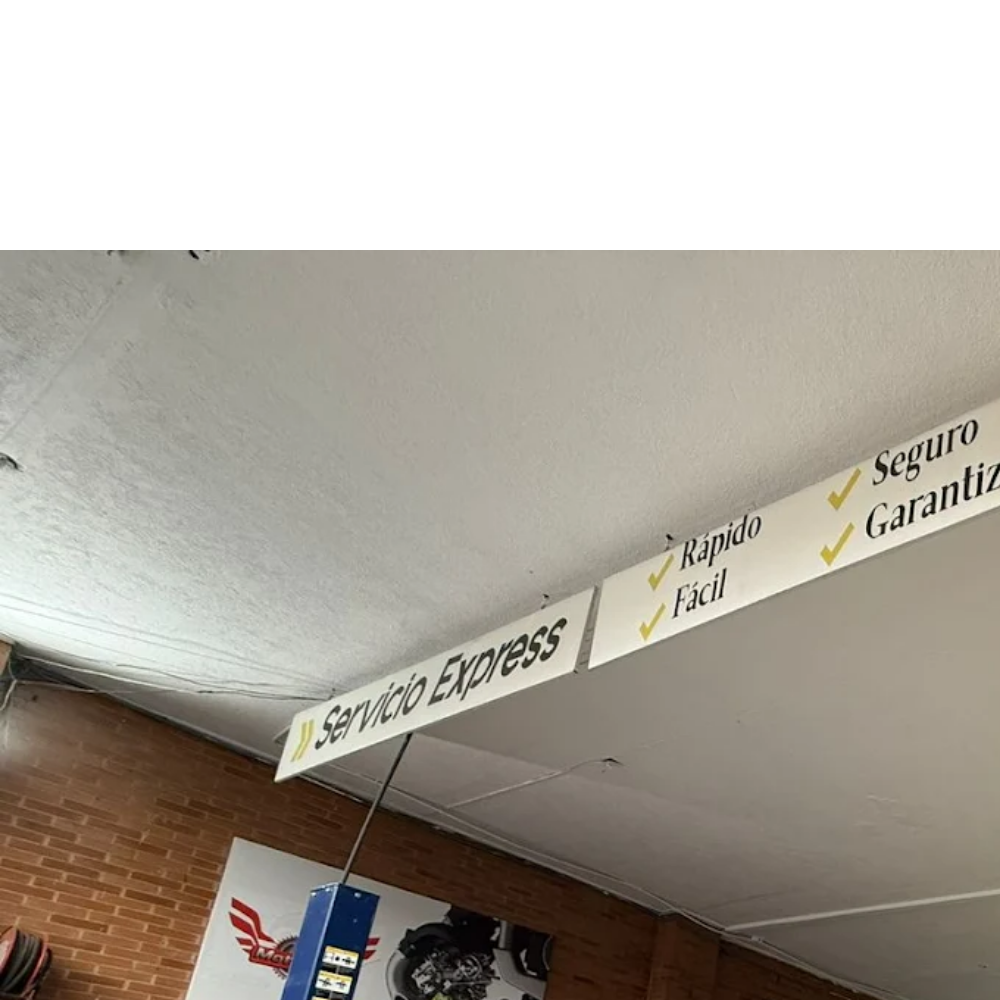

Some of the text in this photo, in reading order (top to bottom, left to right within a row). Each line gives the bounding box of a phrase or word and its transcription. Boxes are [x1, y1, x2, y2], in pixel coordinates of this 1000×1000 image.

[872, 419, 979, 486] Seguro
[680, 513, 762, 570] Rápido
[672, 567, 727, 619] Fácil
[315, 617, 567, 750] Servicio Express
